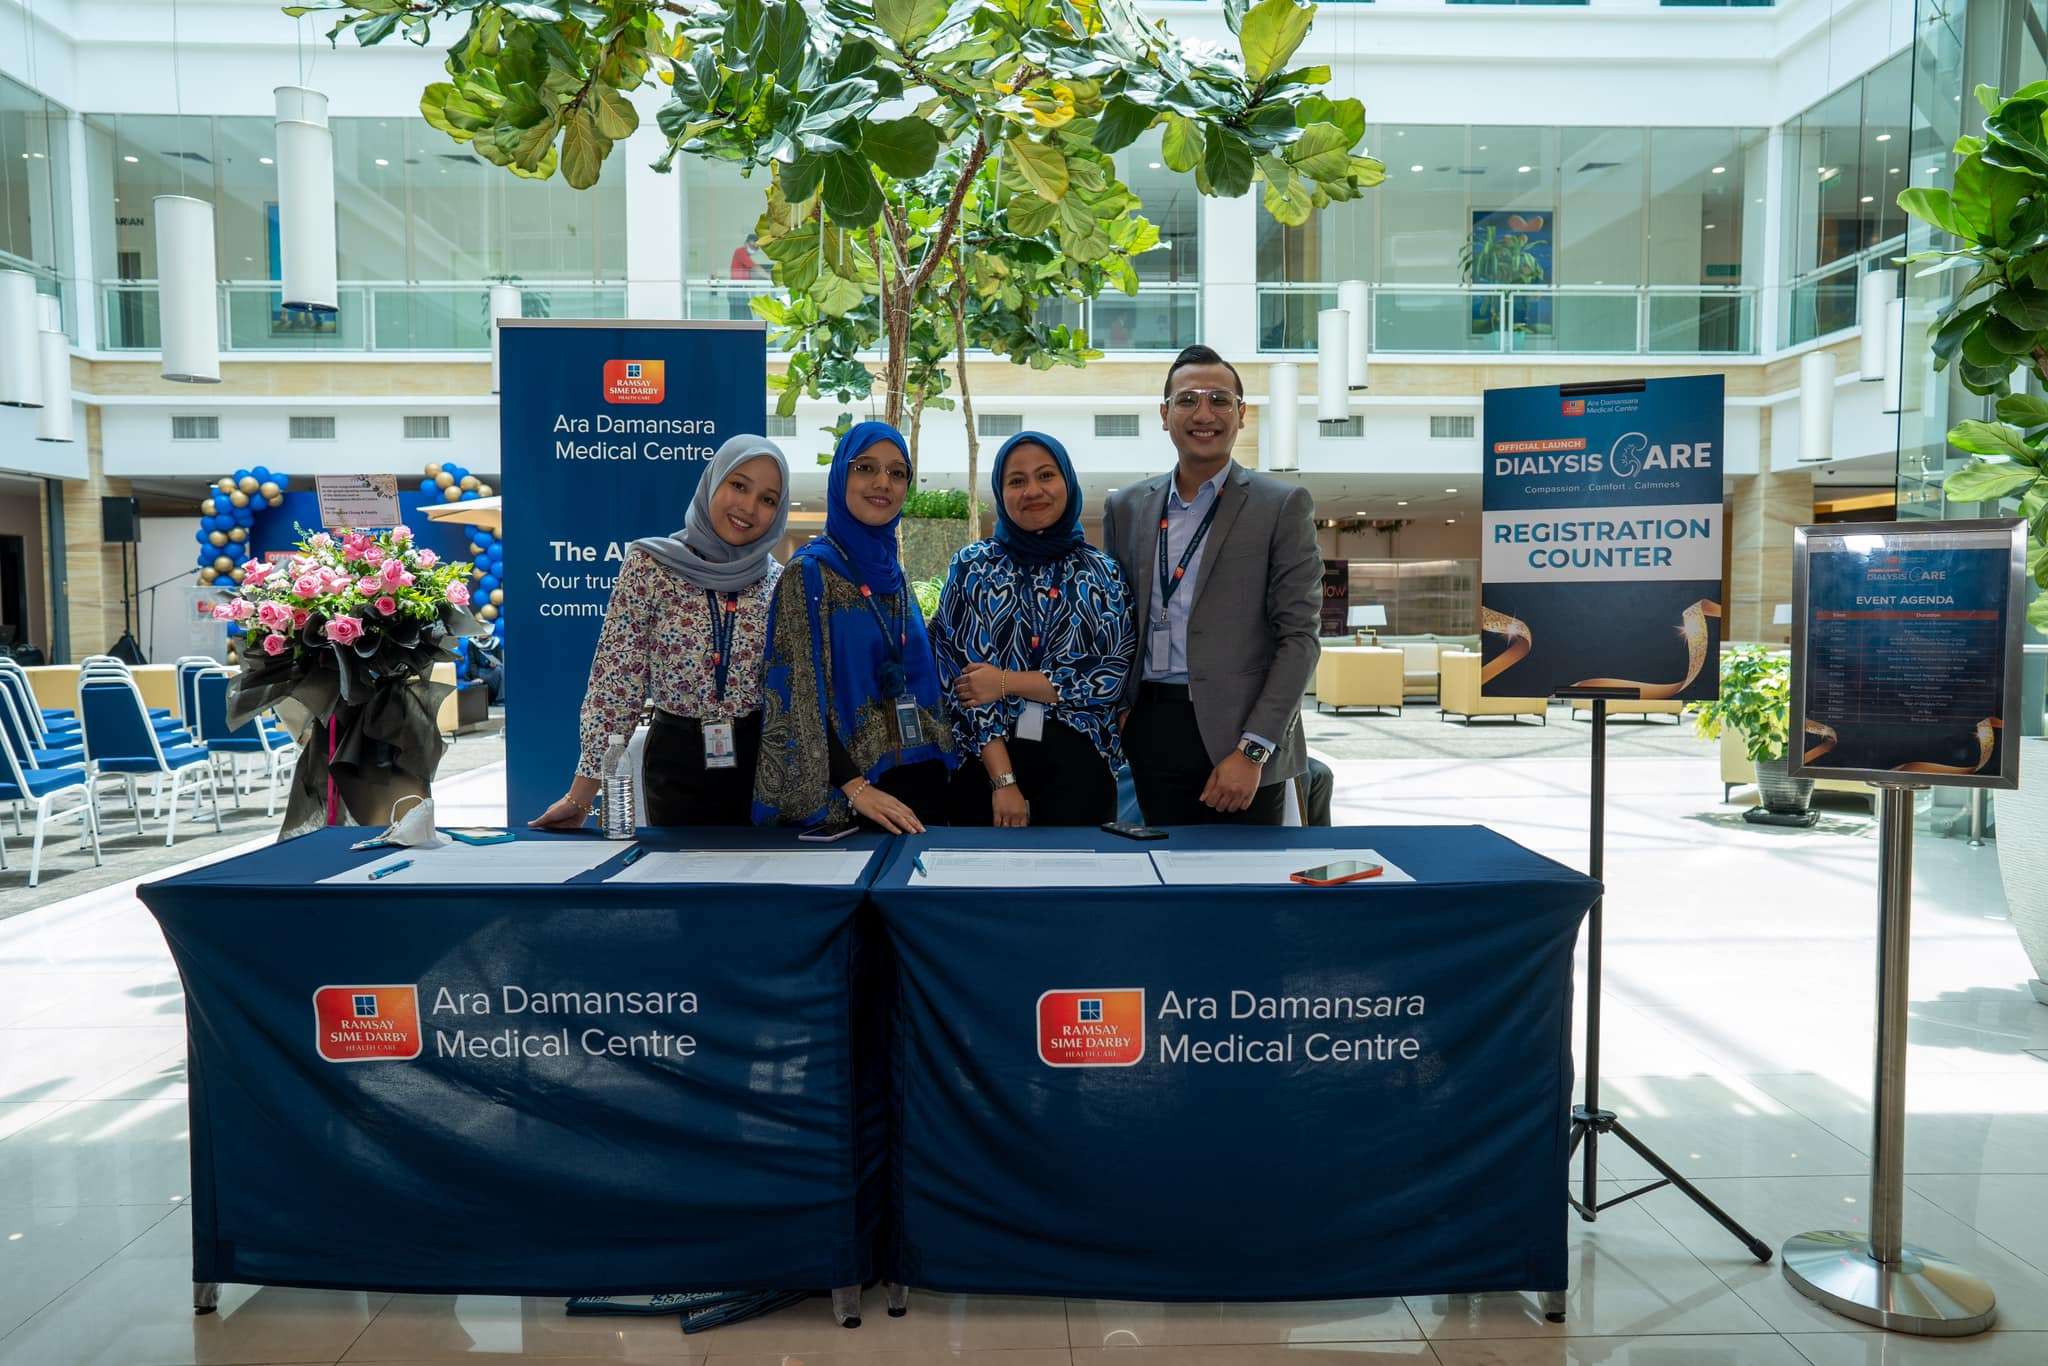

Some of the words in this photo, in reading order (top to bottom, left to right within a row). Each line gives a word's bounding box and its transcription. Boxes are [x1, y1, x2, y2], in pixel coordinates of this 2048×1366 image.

[1586, 406, 1613, 414] Medical
[553, 414, 590, 433] Ara
[597, 414, 715, 435] Damansara
[556, 440, 636, 460] Medical
[644, 441, 715, 461] Centre
[1497, 442, 1539, 451] OFFICIAL
[1542, 440, 1581, 449] LAUNCH
[1495, 453, 1603, 476] DIALYSIS
[1525, 484, 1580, 495] Compassion
[1588, 482, 1626, 492] Comfort
[1634, 480, 1680, 490] Calmness
[1494, 518, 1710, 544] REGISTRATION
[549, 541, 597, 562] The
[1528, 546, 1672, 569] COUNTER
[536, 572, 579, 589] Your
[1867, 572, 1907, 581] DIALYSIS
[1856, 595, 1897, 605] EVENT
[1900, 595, 1955, 605] AGENDA
[432, 986, 491, 1015] Ara
[502, 985, 699, 1015] Damansara
[1158, 990, 1218, 1020] Ara
[1230, 989, 1425, 1020] Damansara
[341, 1020, 394, 1030] RAMSAY
[1062, 1025, 1119, 1036] RAMSAY
[330, 1031, 362, 1042] SIME
[365, 1032, 408, 1042] DARBY
[436, 1028, 570, 1058] Medical
[580, 1028, 697, 1058] Centre
[1051, 1038, 1083, 1049] SIME
[1086, 1037, 1131, 1049] DARBY
[345, 1044, 376, 1052] HEALTH
[1159, 1033, 1293, 1064] Medical
[1304, 1033, 1420, 1062] Centre
